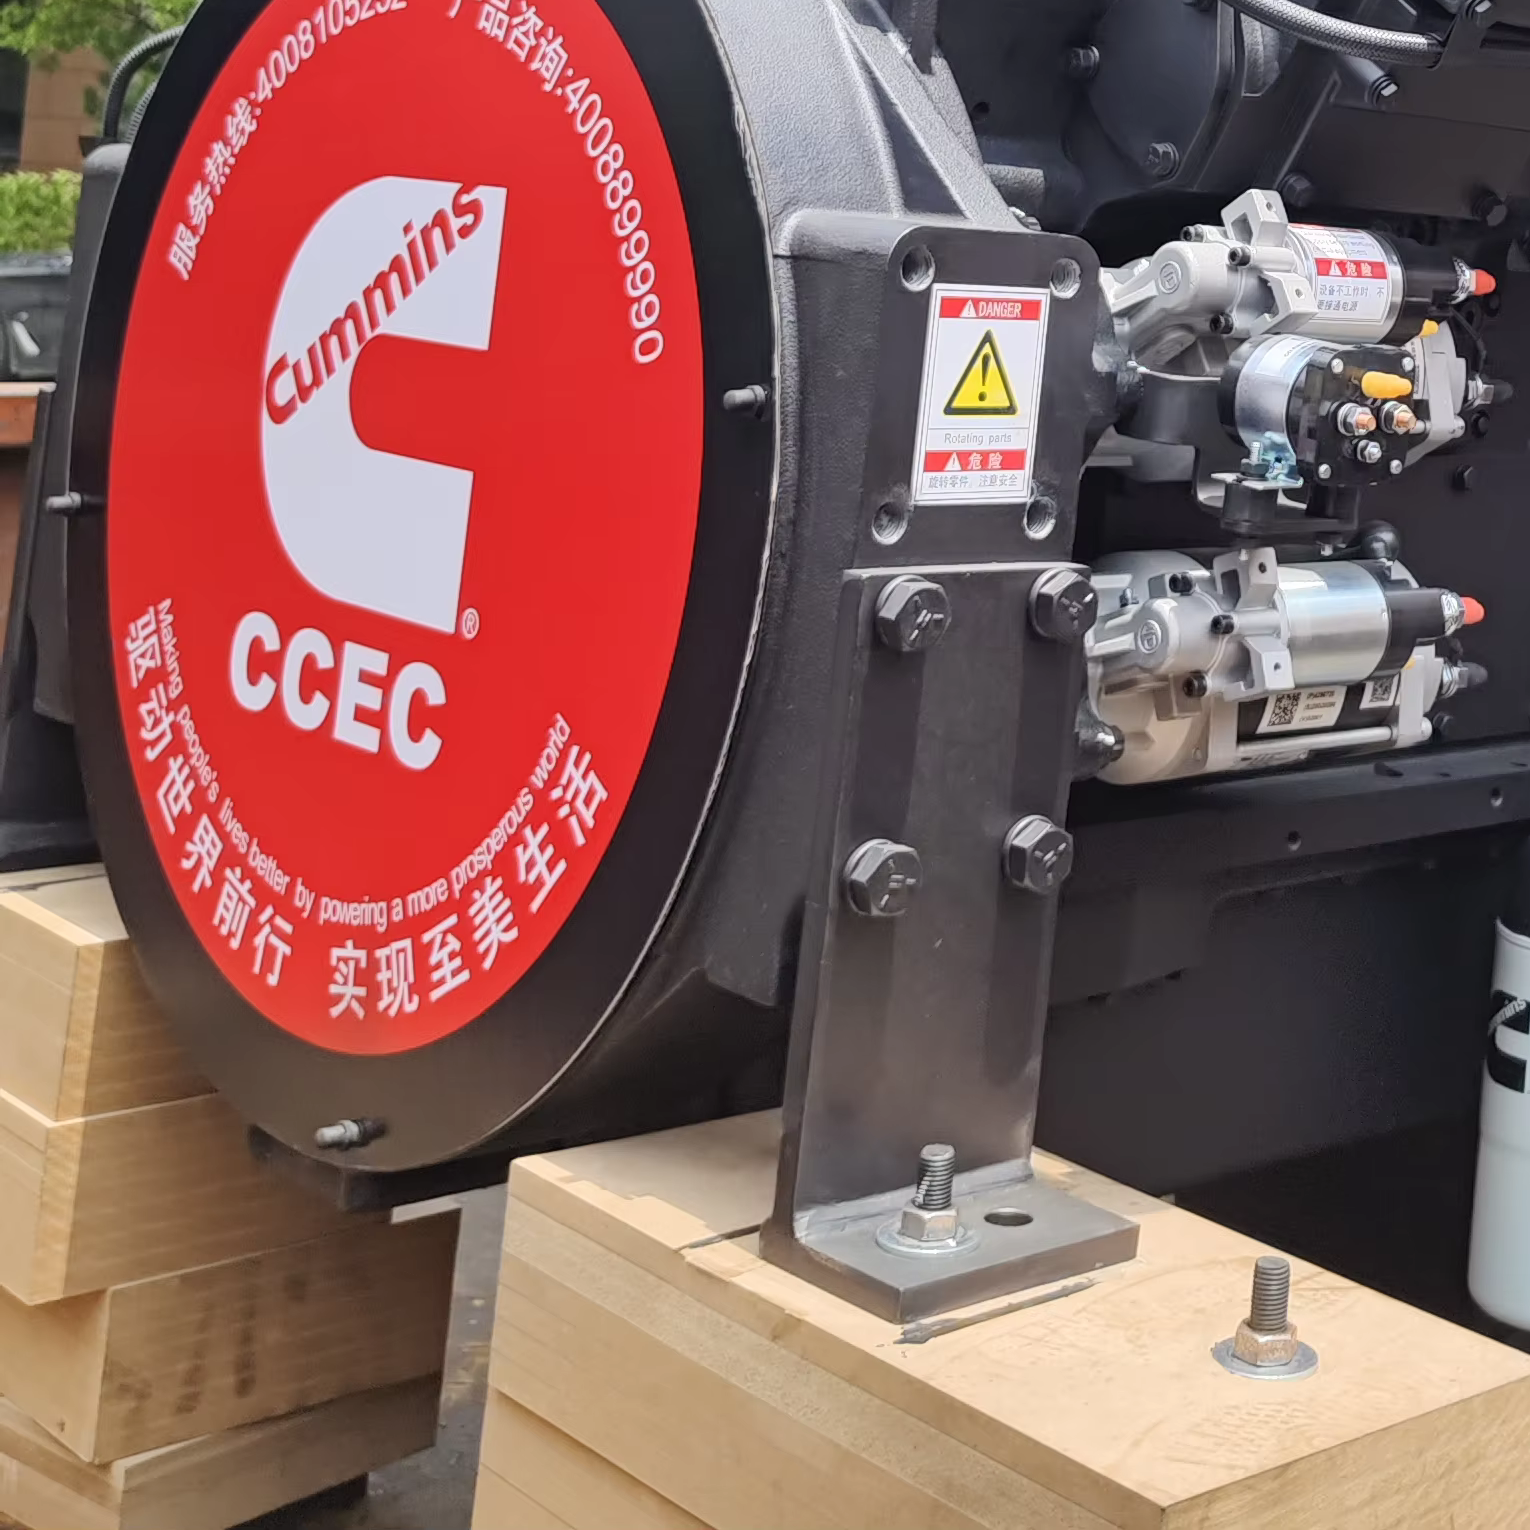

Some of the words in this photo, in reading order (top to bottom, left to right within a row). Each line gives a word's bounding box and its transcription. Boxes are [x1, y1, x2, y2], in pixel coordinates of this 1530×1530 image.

[265, 182, 485, 426] Cummins
[978, 301, 1022, 318] DANGER
[944, 432, 984, 446] Rotating
[988, 432, 1012, 446] parts
[967, 452, 1003, 470] 危险
[229, 610, 447, 771] CCEC
[156, 597, 184, 701] Making
[176, 703, 220, 803] people's
[218, 796, 250, 854] lives
[247, 837, 291, 896] better
[293, 876, 316, 919] by
[319, 894, 388, 933] powering
[391, 897, 404, 923] a
[407, 876, 449, 917] more
[449, 786, 534, 900] prosperous
[530, 711, 572, 790] world
